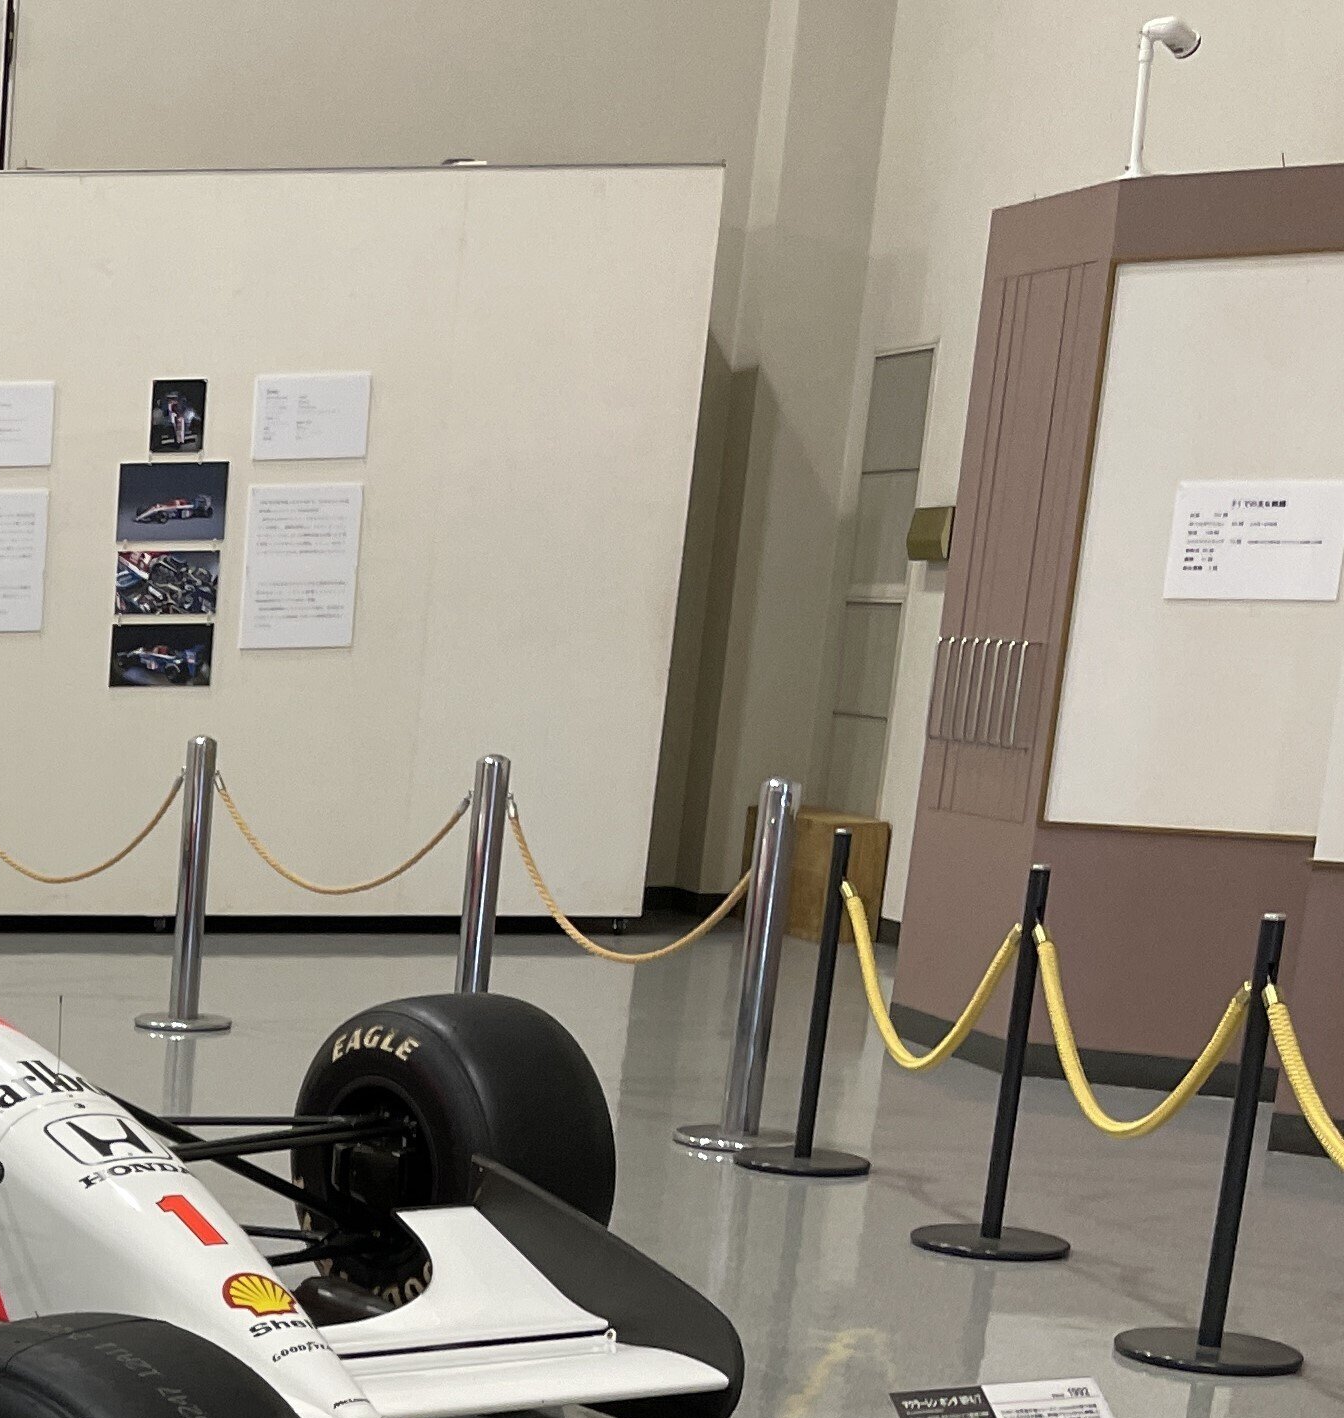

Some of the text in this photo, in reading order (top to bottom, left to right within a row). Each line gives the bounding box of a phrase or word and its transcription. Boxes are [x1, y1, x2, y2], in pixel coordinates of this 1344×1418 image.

[331, 1024, 421, 1062] EAGLE
[156, 1195, 229, 1247] 1
[272, 1341, 333, 1362] GOODYE
